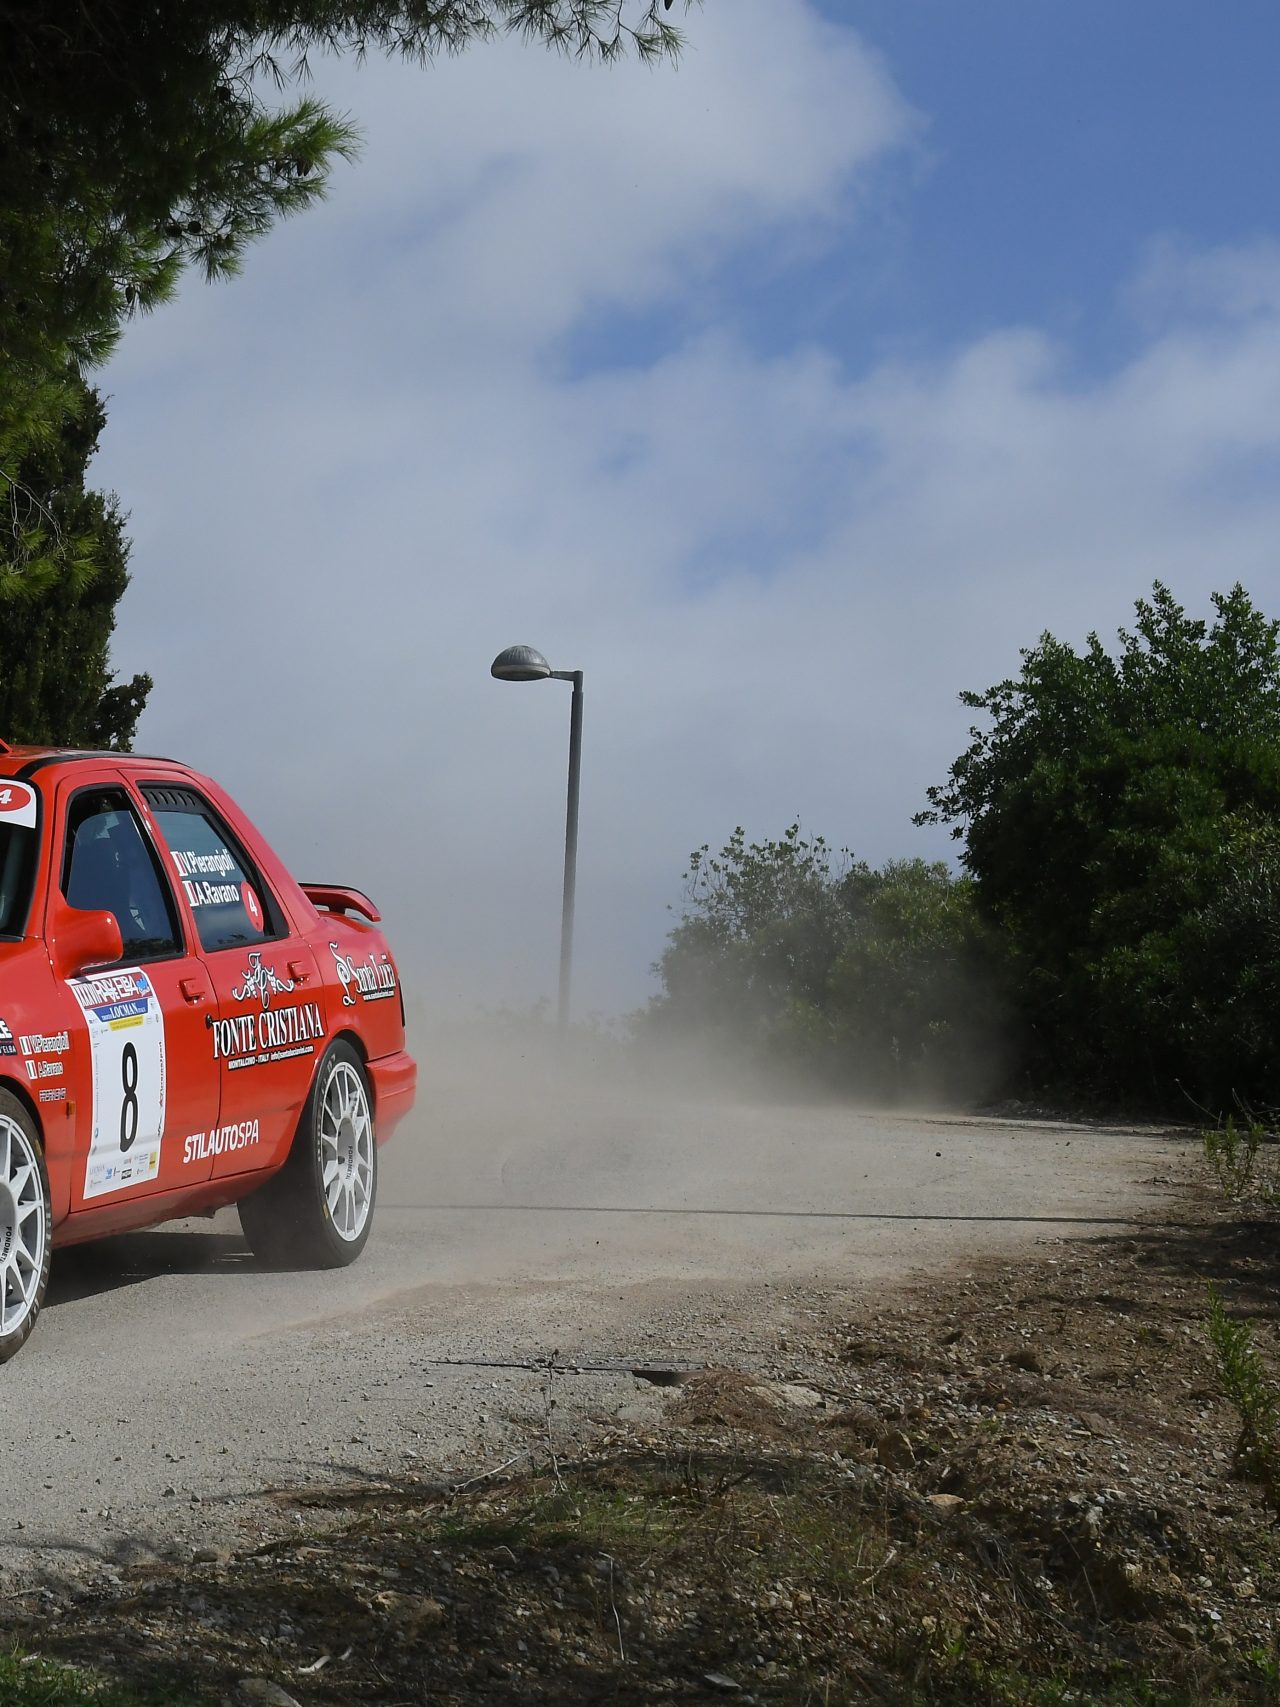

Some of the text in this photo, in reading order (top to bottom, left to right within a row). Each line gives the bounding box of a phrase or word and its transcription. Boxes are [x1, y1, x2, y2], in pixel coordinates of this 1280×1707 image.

[195, 881, 240, 905] A.Ravano
[247, 890, 258, 917] 4
[213, 1003, 325, 1058] FONTE CRISTIANA
[120, 1042, 138, 1152] 8
